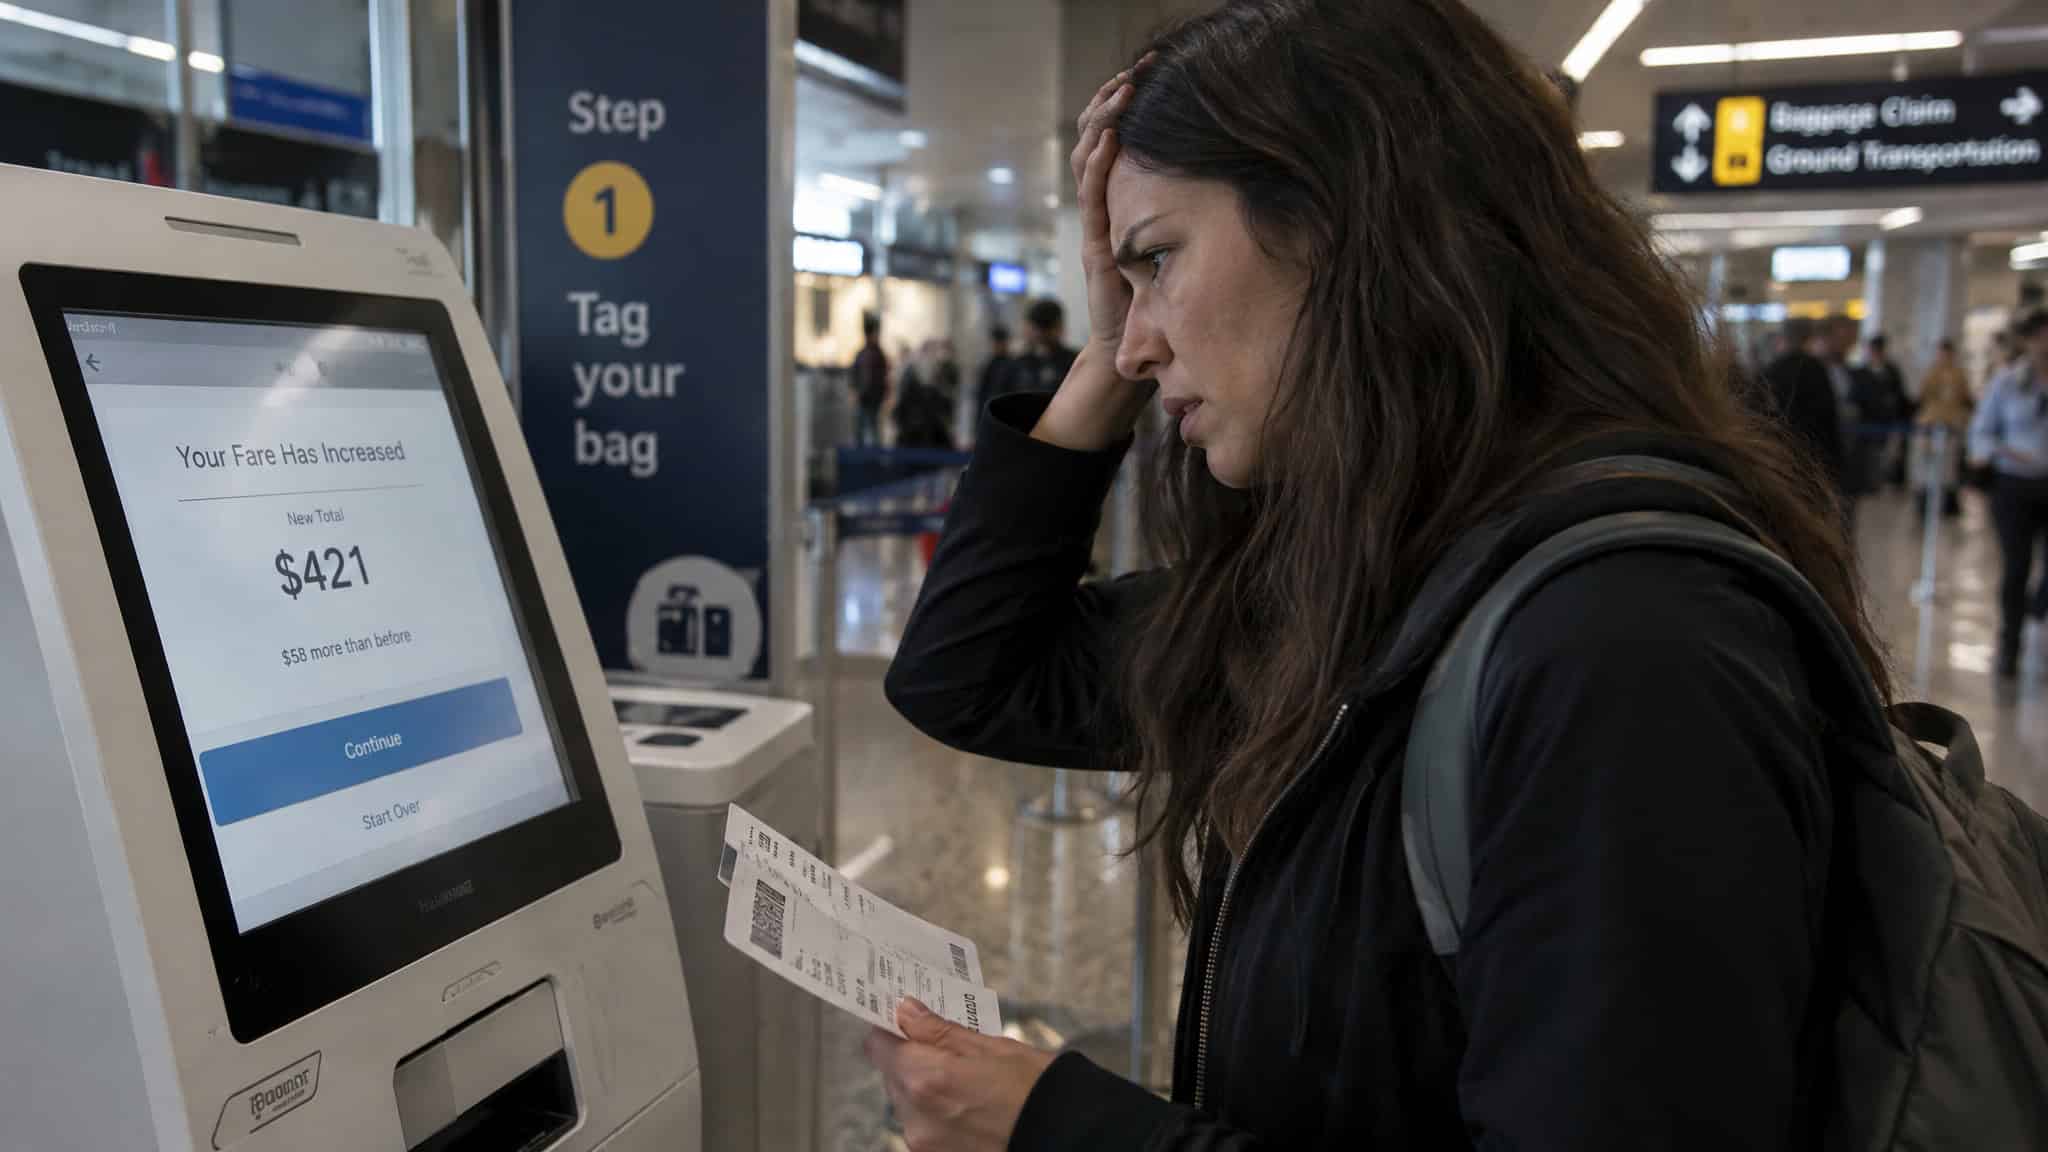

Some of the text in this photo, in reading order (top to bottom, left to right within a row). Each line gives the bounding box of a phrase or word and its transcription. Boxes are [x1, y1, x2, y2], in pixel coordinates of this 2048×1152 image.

[568, 91, 666, 141] Step
[1770, 95, 1956, 136] Baggage Claim
[1766, 141, 1859, 174] Ground
[1863, 135, 2041, 173] Transportation
[593, 185, 616, 237] 1
[567, 291, 649, 347] Tag
[573, 361, 684, 407] your
[176, 440, 406, 469] Your Fare Has Increased
[575, 419, 658, 477] bag
[287, 508, 344, 525] New Total
[275, 545, 369, 600] $421
[281, 629, 412, 667] $58 more than before
[344, 733, 402, 759] Continue
[362, 800, 421, 830] Start Over
